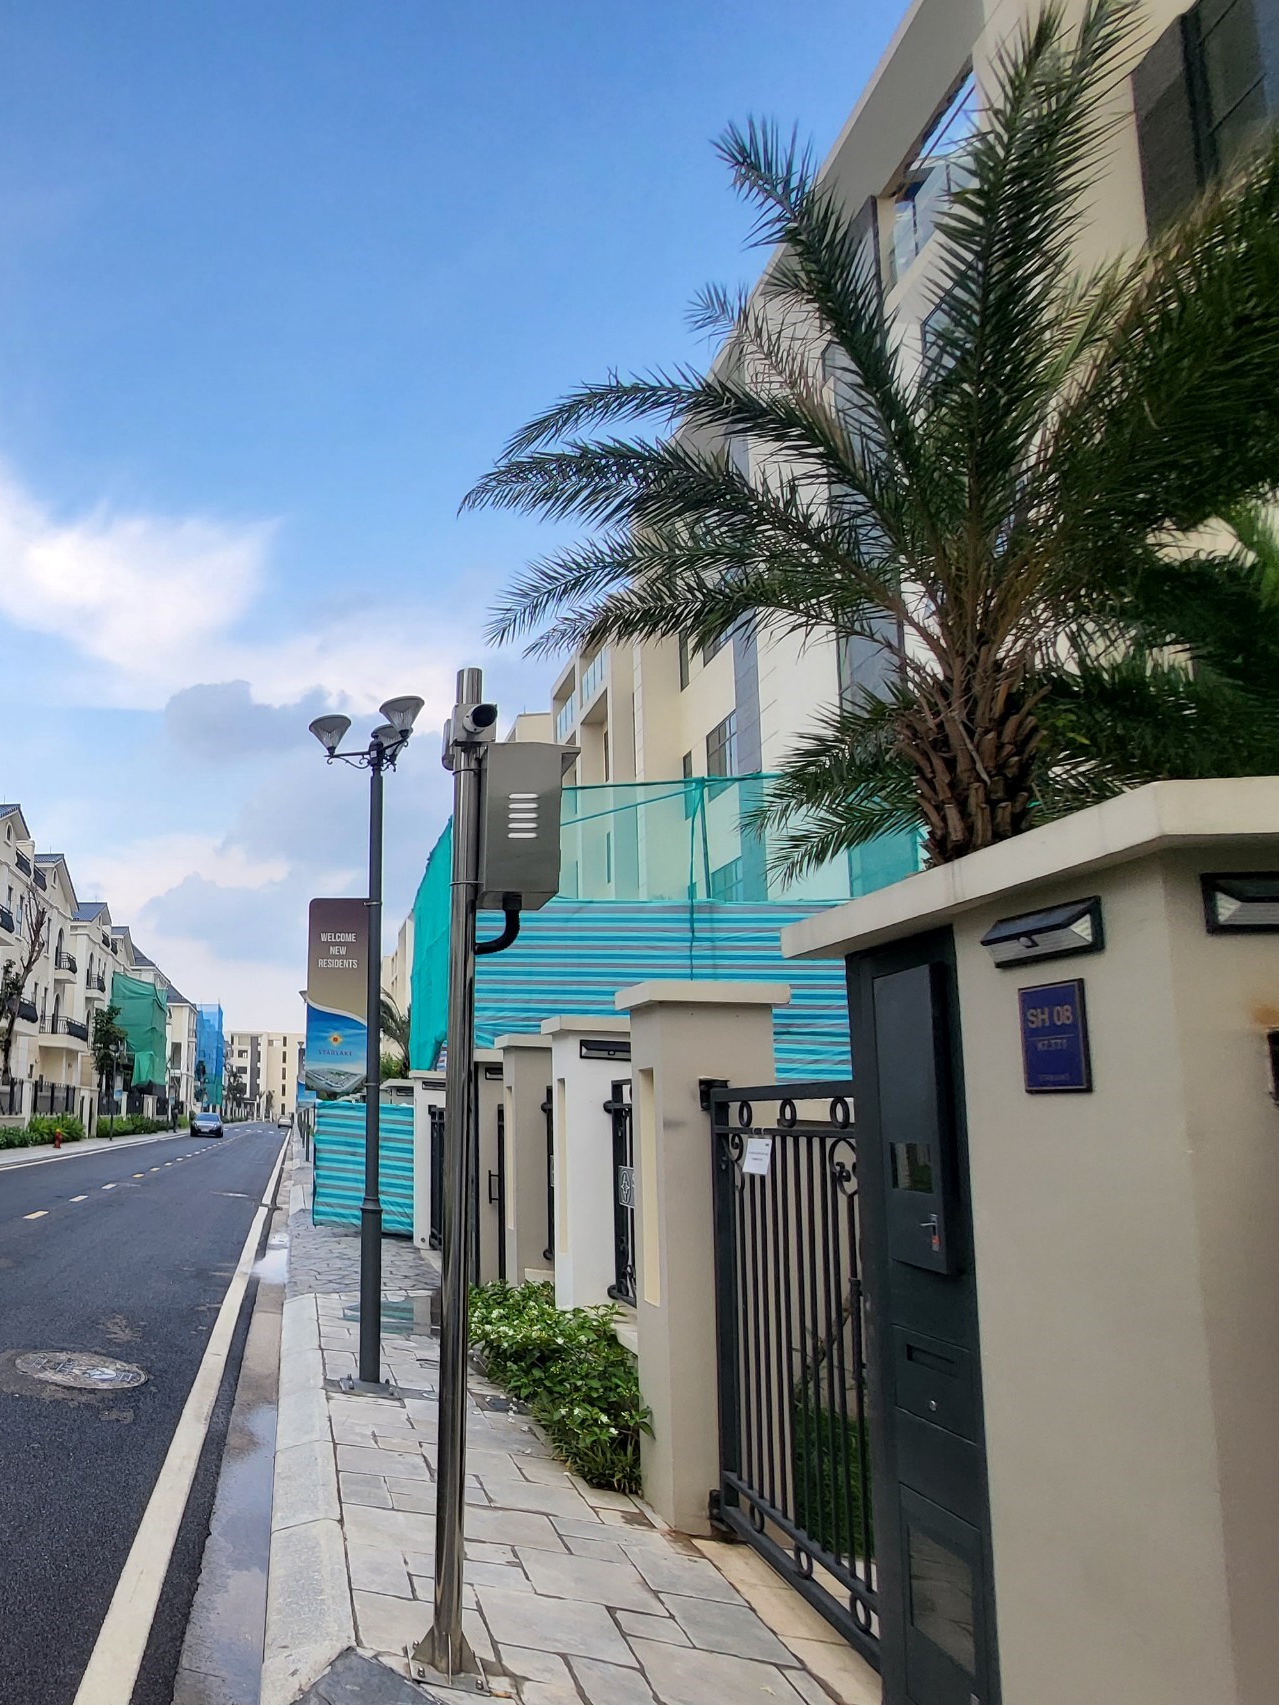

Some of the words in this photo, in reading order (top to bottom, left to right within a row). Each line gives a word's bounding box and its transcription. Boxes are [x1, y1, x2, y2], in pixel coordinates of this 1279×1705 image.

[320, 932, 357, 942] WELCOME
[329, 946, 347, 955] NEW
[318, 958, 358, 969] RESIDENTS
[1027, 1007, 1050, 1028] SH
